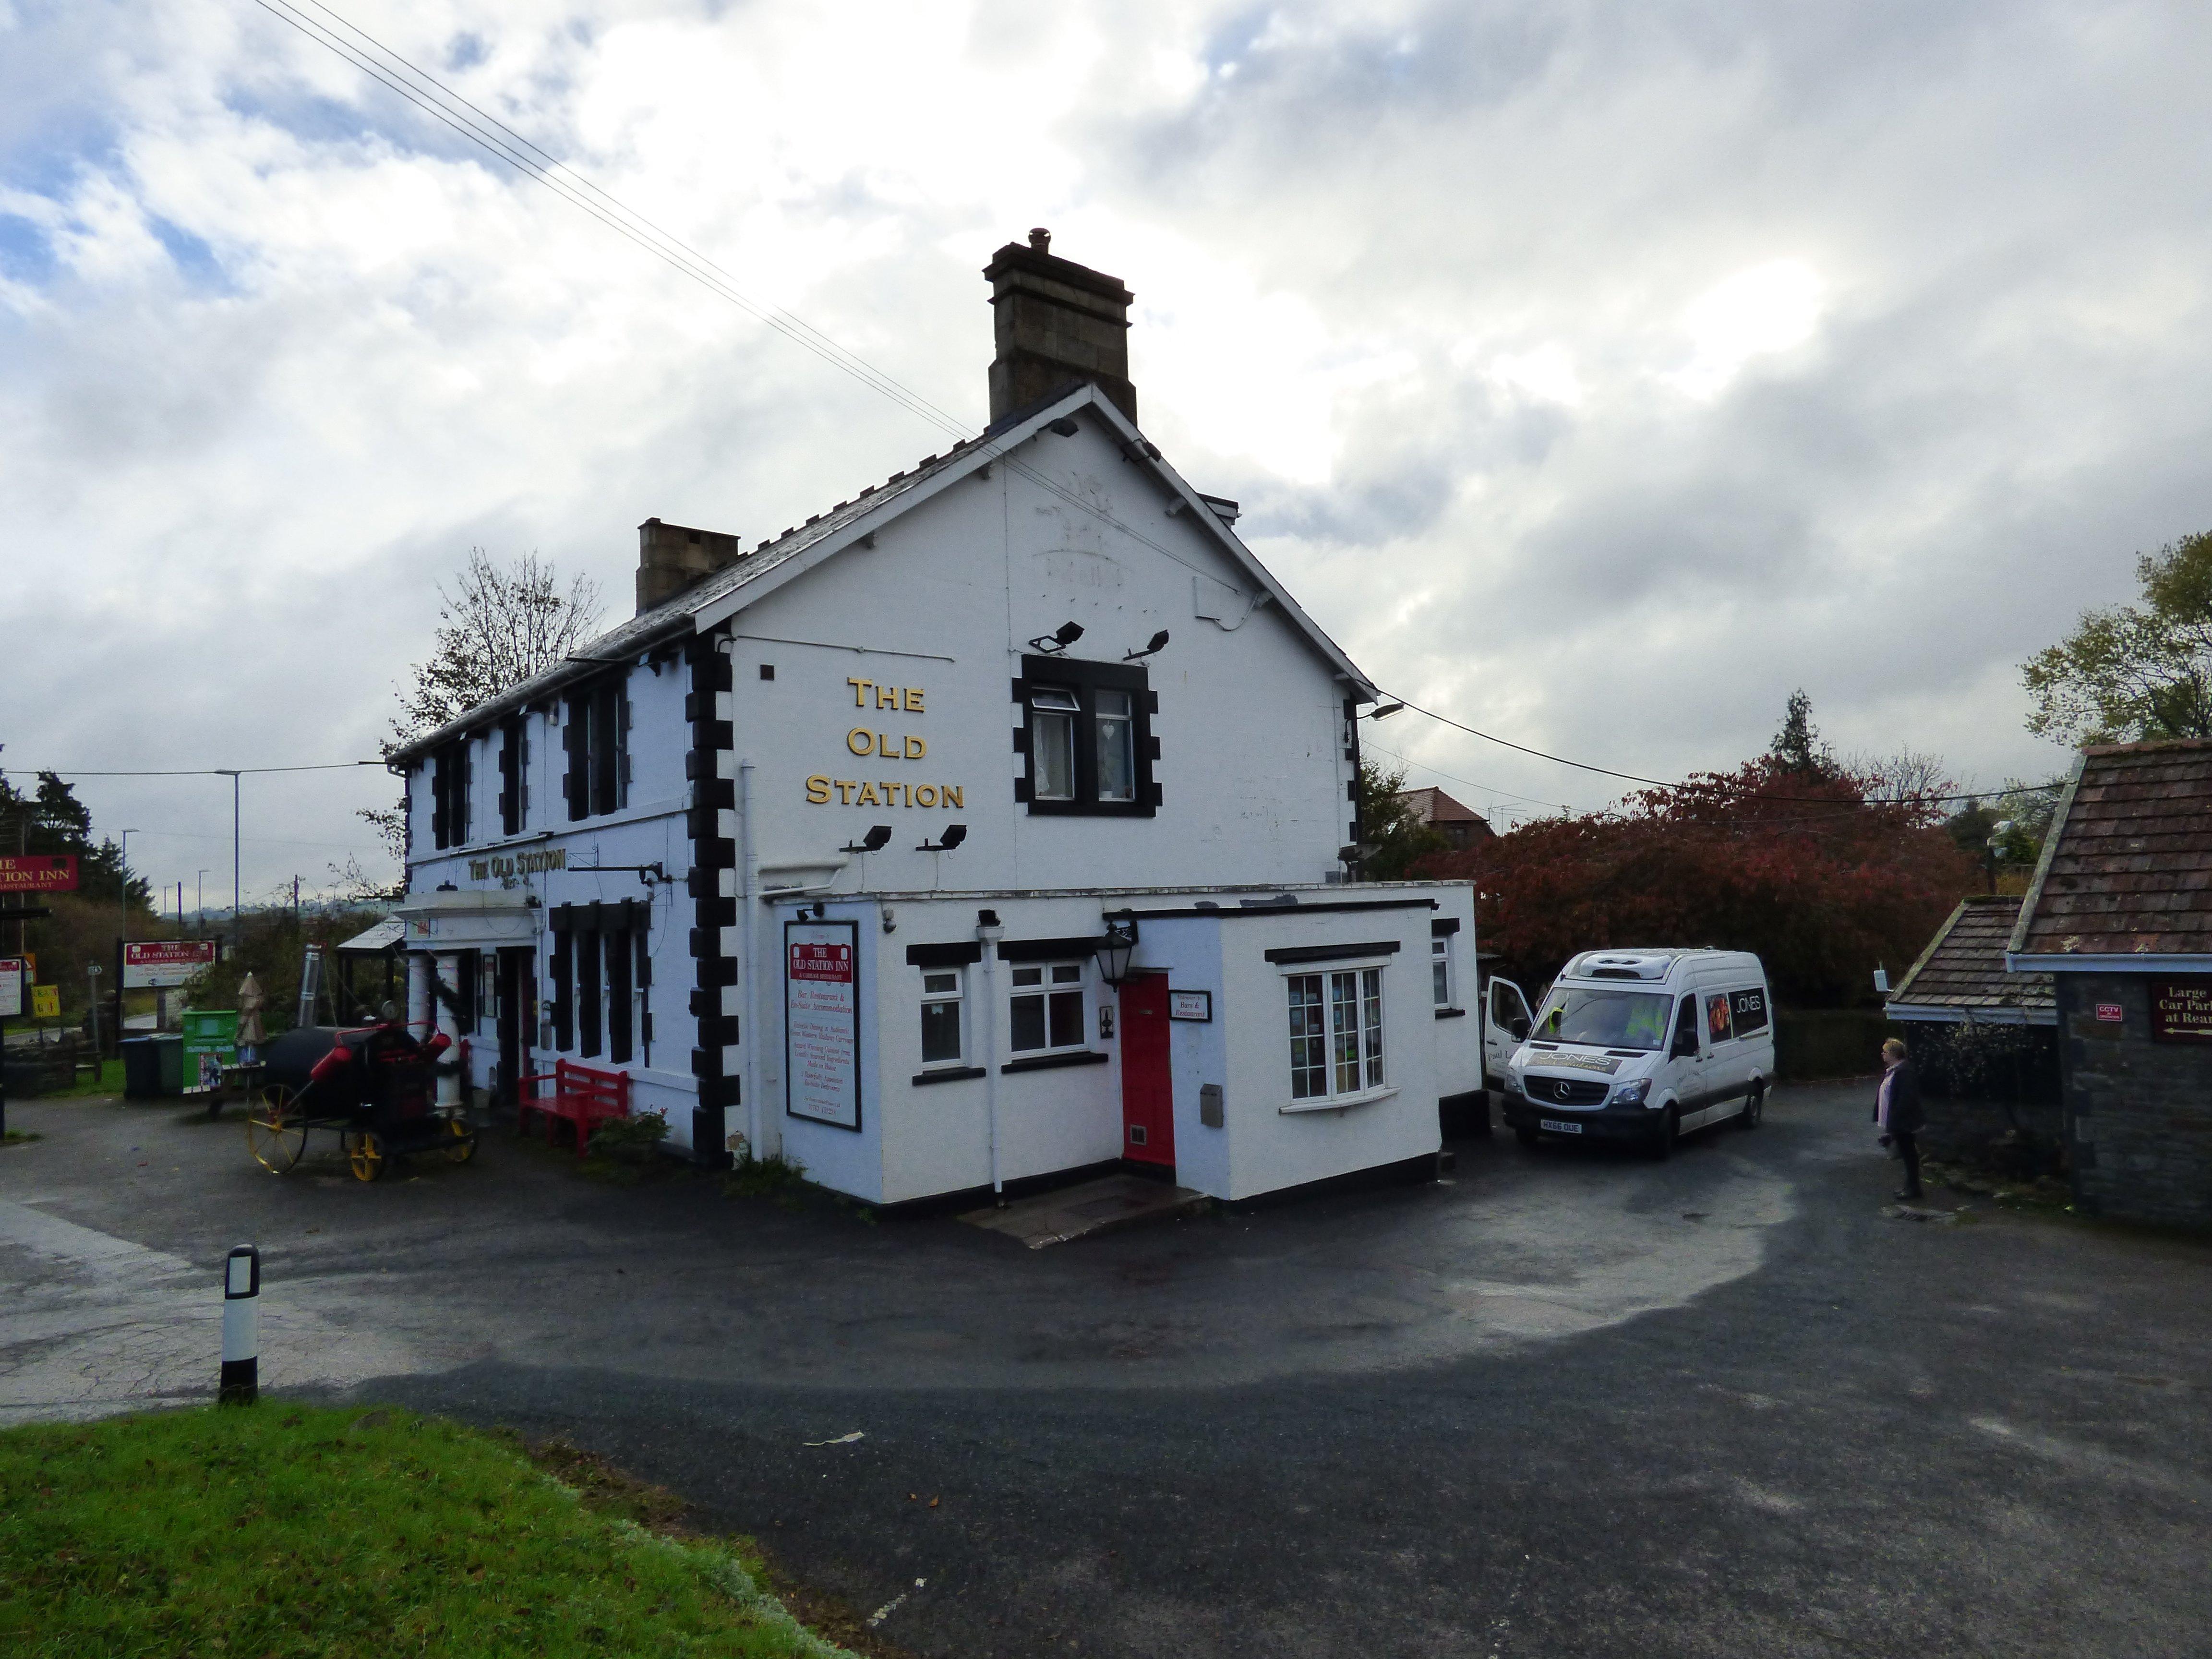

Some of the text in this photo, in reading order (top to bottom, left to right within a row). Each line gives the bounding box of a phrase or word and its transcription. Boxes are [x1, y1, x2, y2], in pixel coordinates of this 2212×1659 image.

[847, 727, 927, 759] OLD
[806, 774, 964, 808] STATION
[39, 870, 70, 881] INN
[161, 944, 180, 952] THE
[813, 947, 827, 958] THE
[152, 950, 189, 959] STATION
[793, 959, 848, 971] OLD STATION INN
[2168, 987, 2207, 1000] Large
[1736, 995, 1761, 1013] JONES
[2159, 999, 2183, 1010] Car
[2165, 1013, 2178, 1022] at
[1539, 1053, 1611, 1066] JONES
